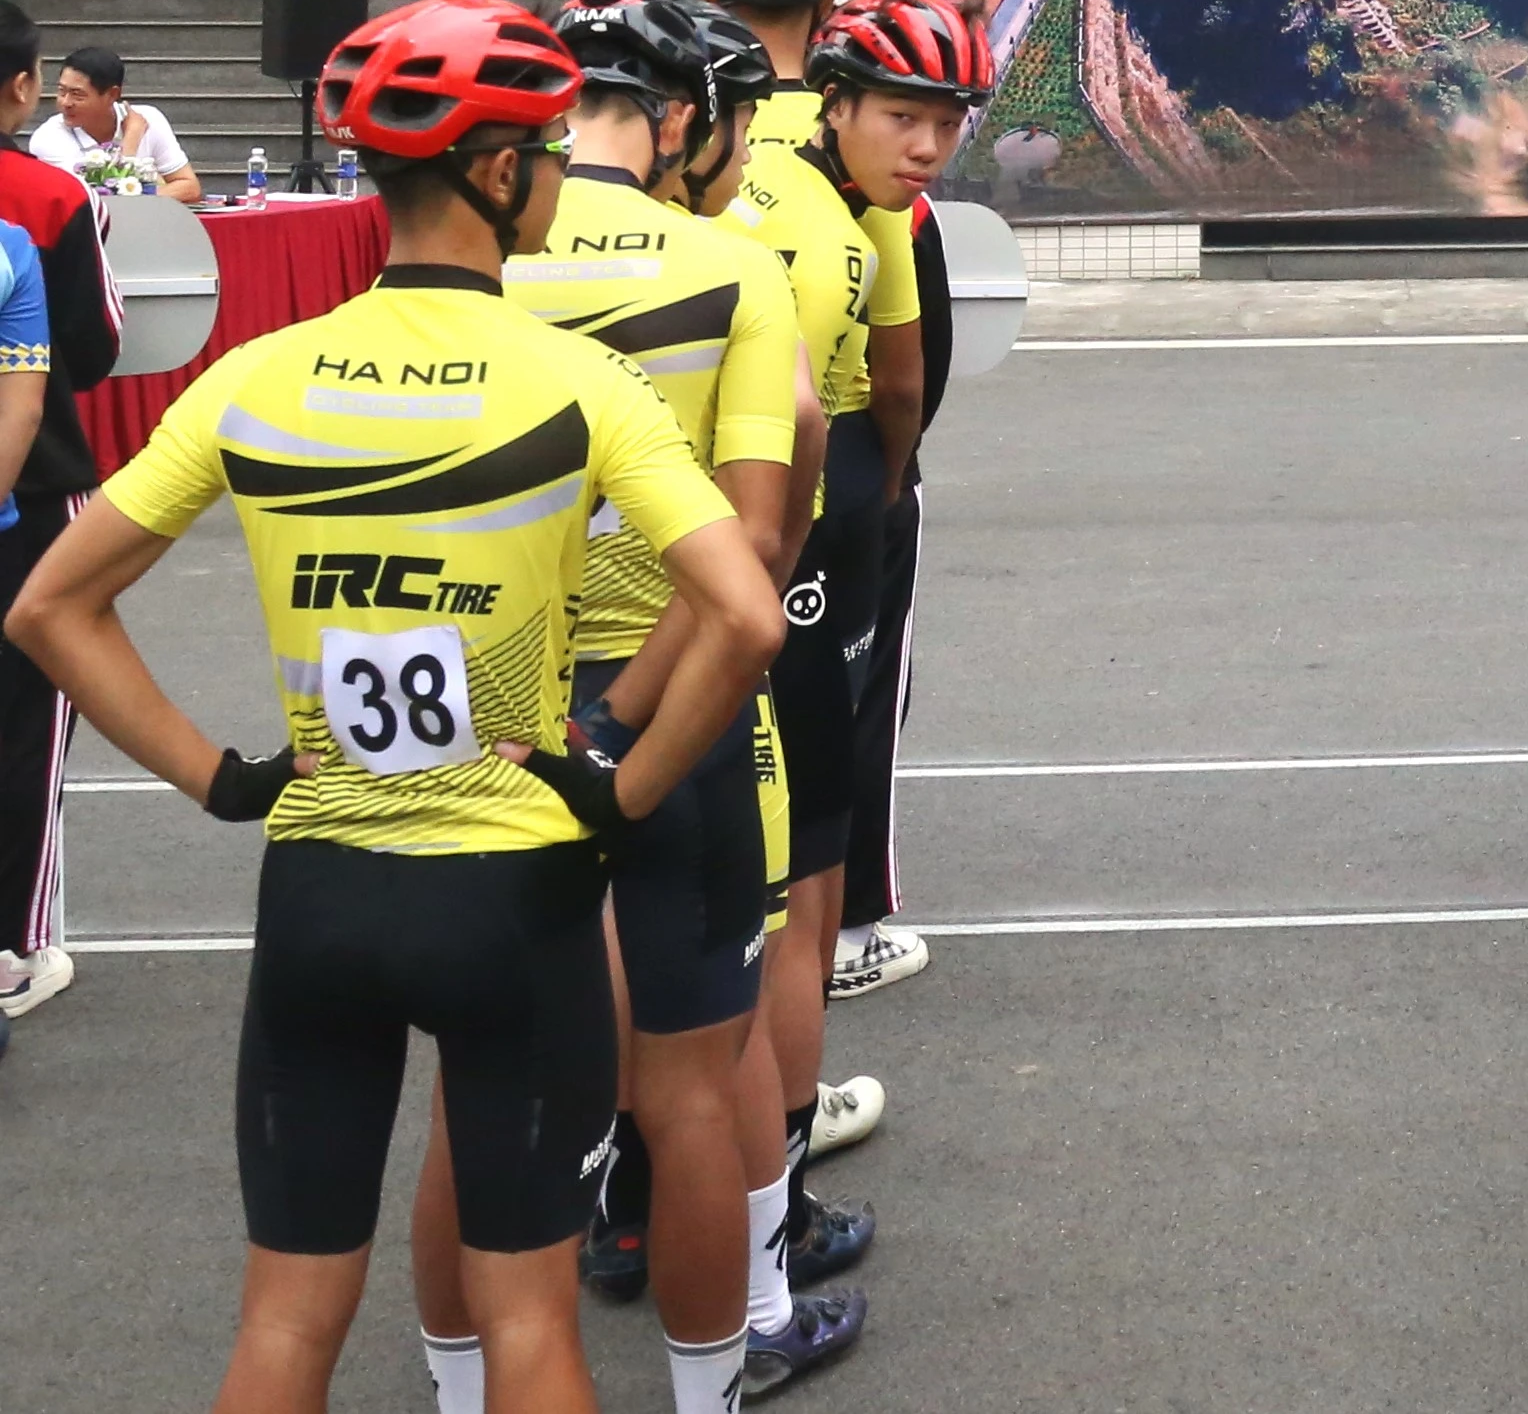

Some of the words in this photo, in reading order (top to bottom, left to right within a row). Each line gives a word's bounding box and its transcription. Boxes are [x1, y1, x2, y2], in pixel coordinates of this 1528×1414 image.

[574, 8, 623, 23] KASK
[571, 233, 666, 254] NOI
[313, 354, 383, 384] HA
[400, 361, 488, 386] NOI
[435, 582, 503, 615] TIRE
[342, 653, 456, 754] 38
